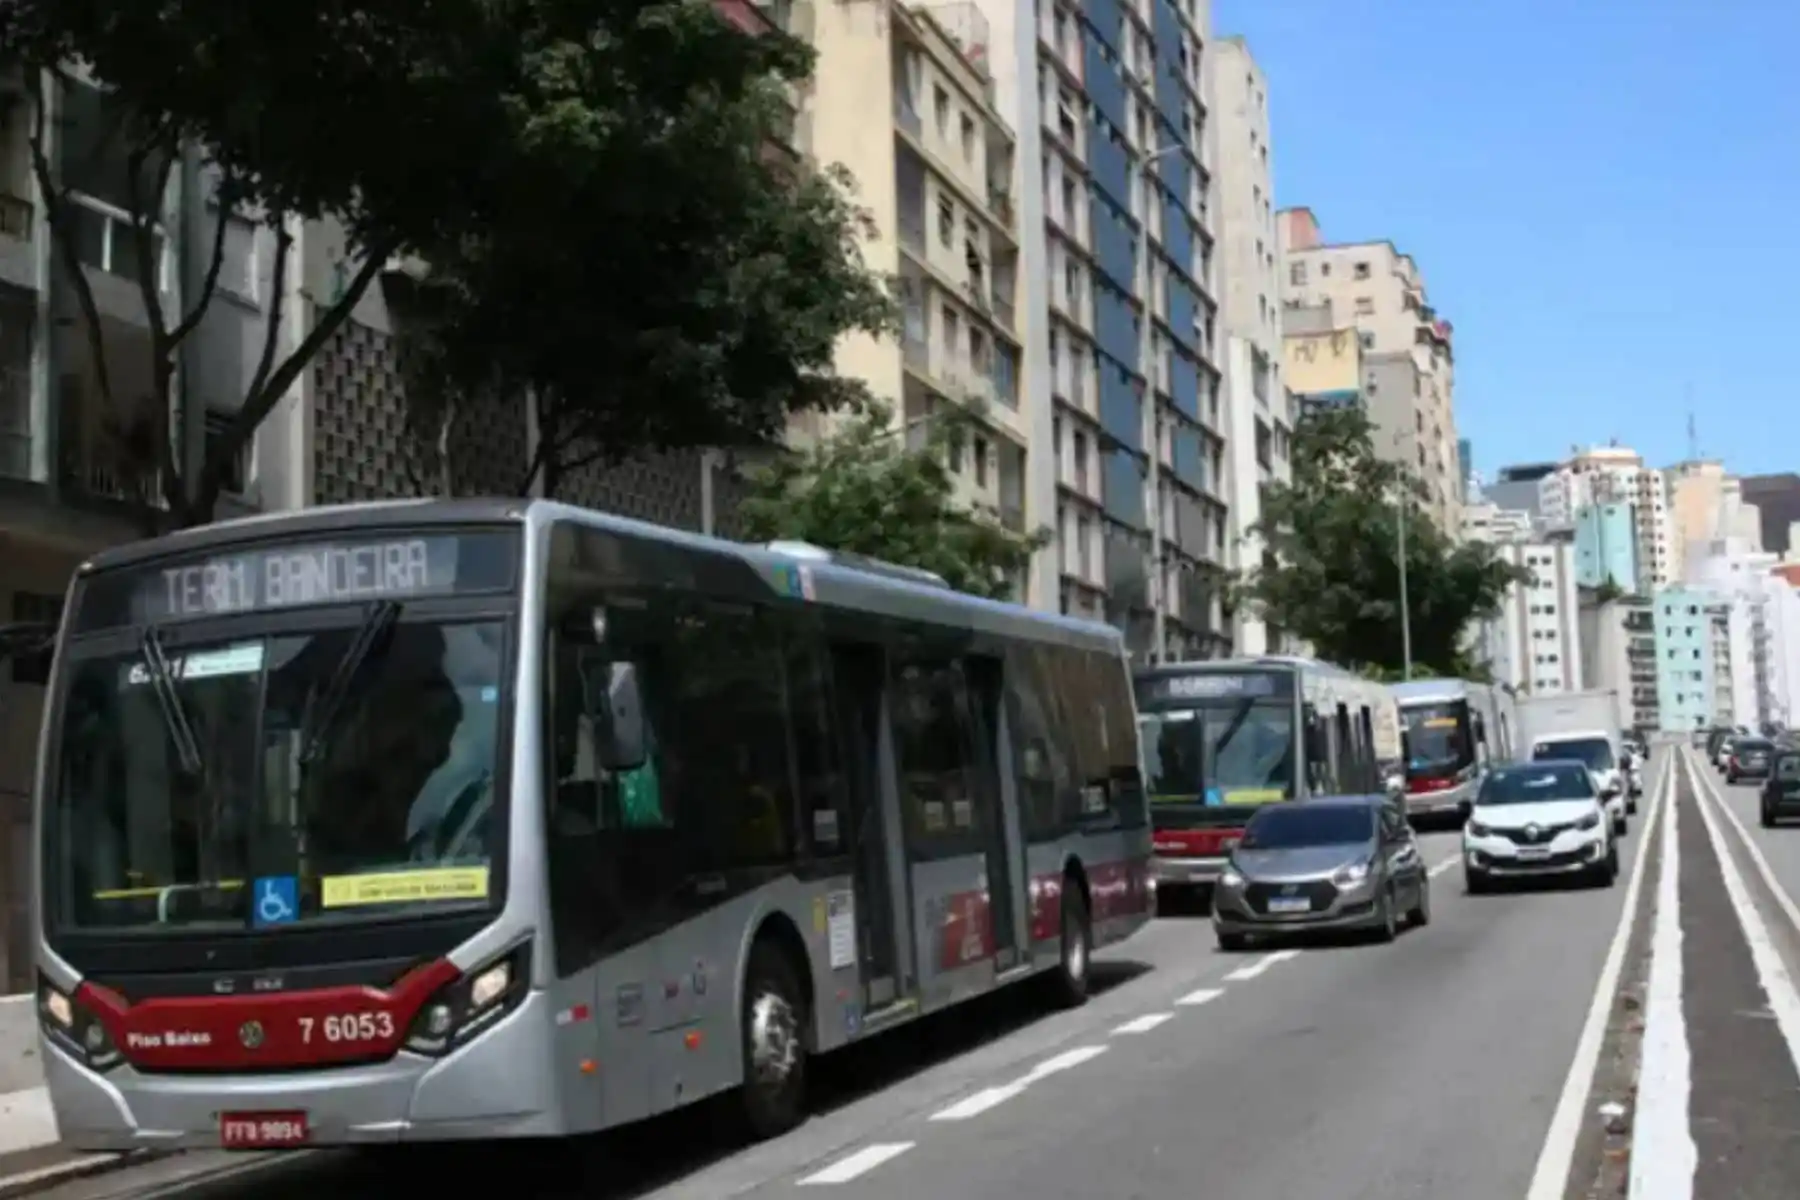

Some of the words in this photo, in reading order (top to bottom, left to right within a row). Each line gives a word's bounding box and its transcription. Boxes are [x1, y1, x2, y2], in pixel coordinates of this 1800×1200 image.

[265, 541, 428, 604] BANDEIRA
[298, 1017, 314, 1044] 7
[323, 1012, 394, 1042] 6053
